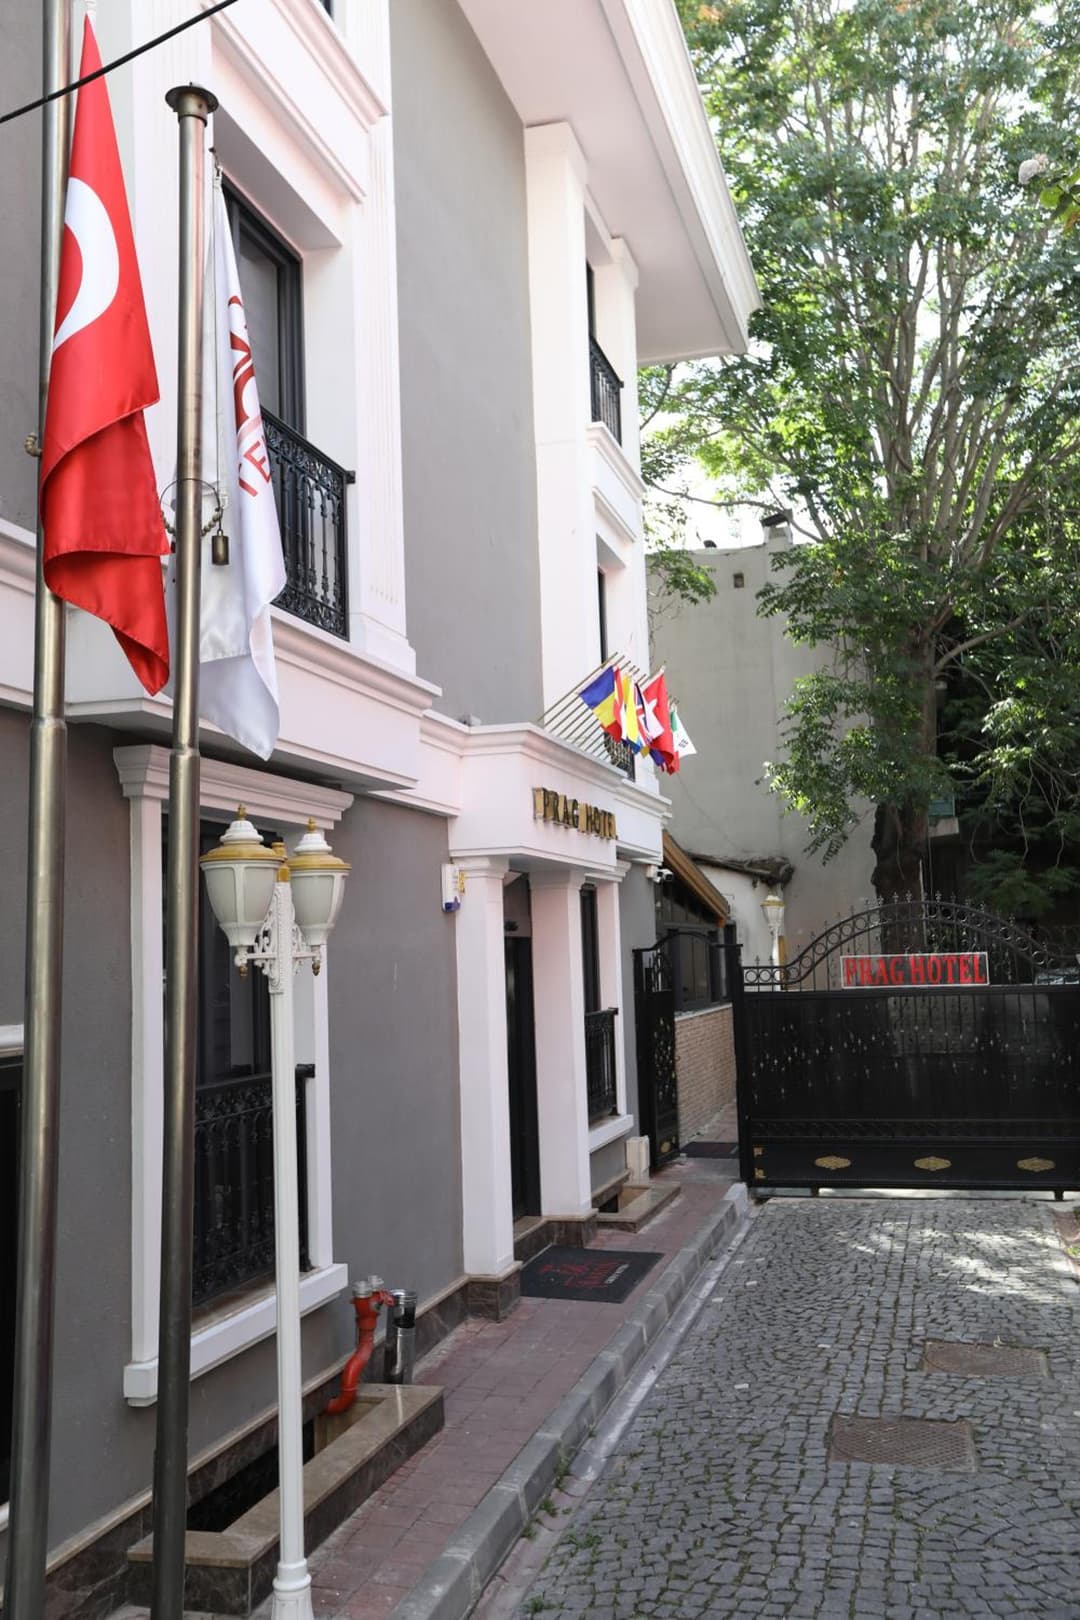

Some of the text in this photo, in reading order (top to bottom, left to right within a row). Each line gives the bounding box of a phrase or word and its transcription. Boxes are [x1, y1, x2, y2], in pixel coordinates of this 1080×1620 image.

[533, 787, 580, 829] PRAG
[844, 953, 986, 986] PRAG HOTEL
